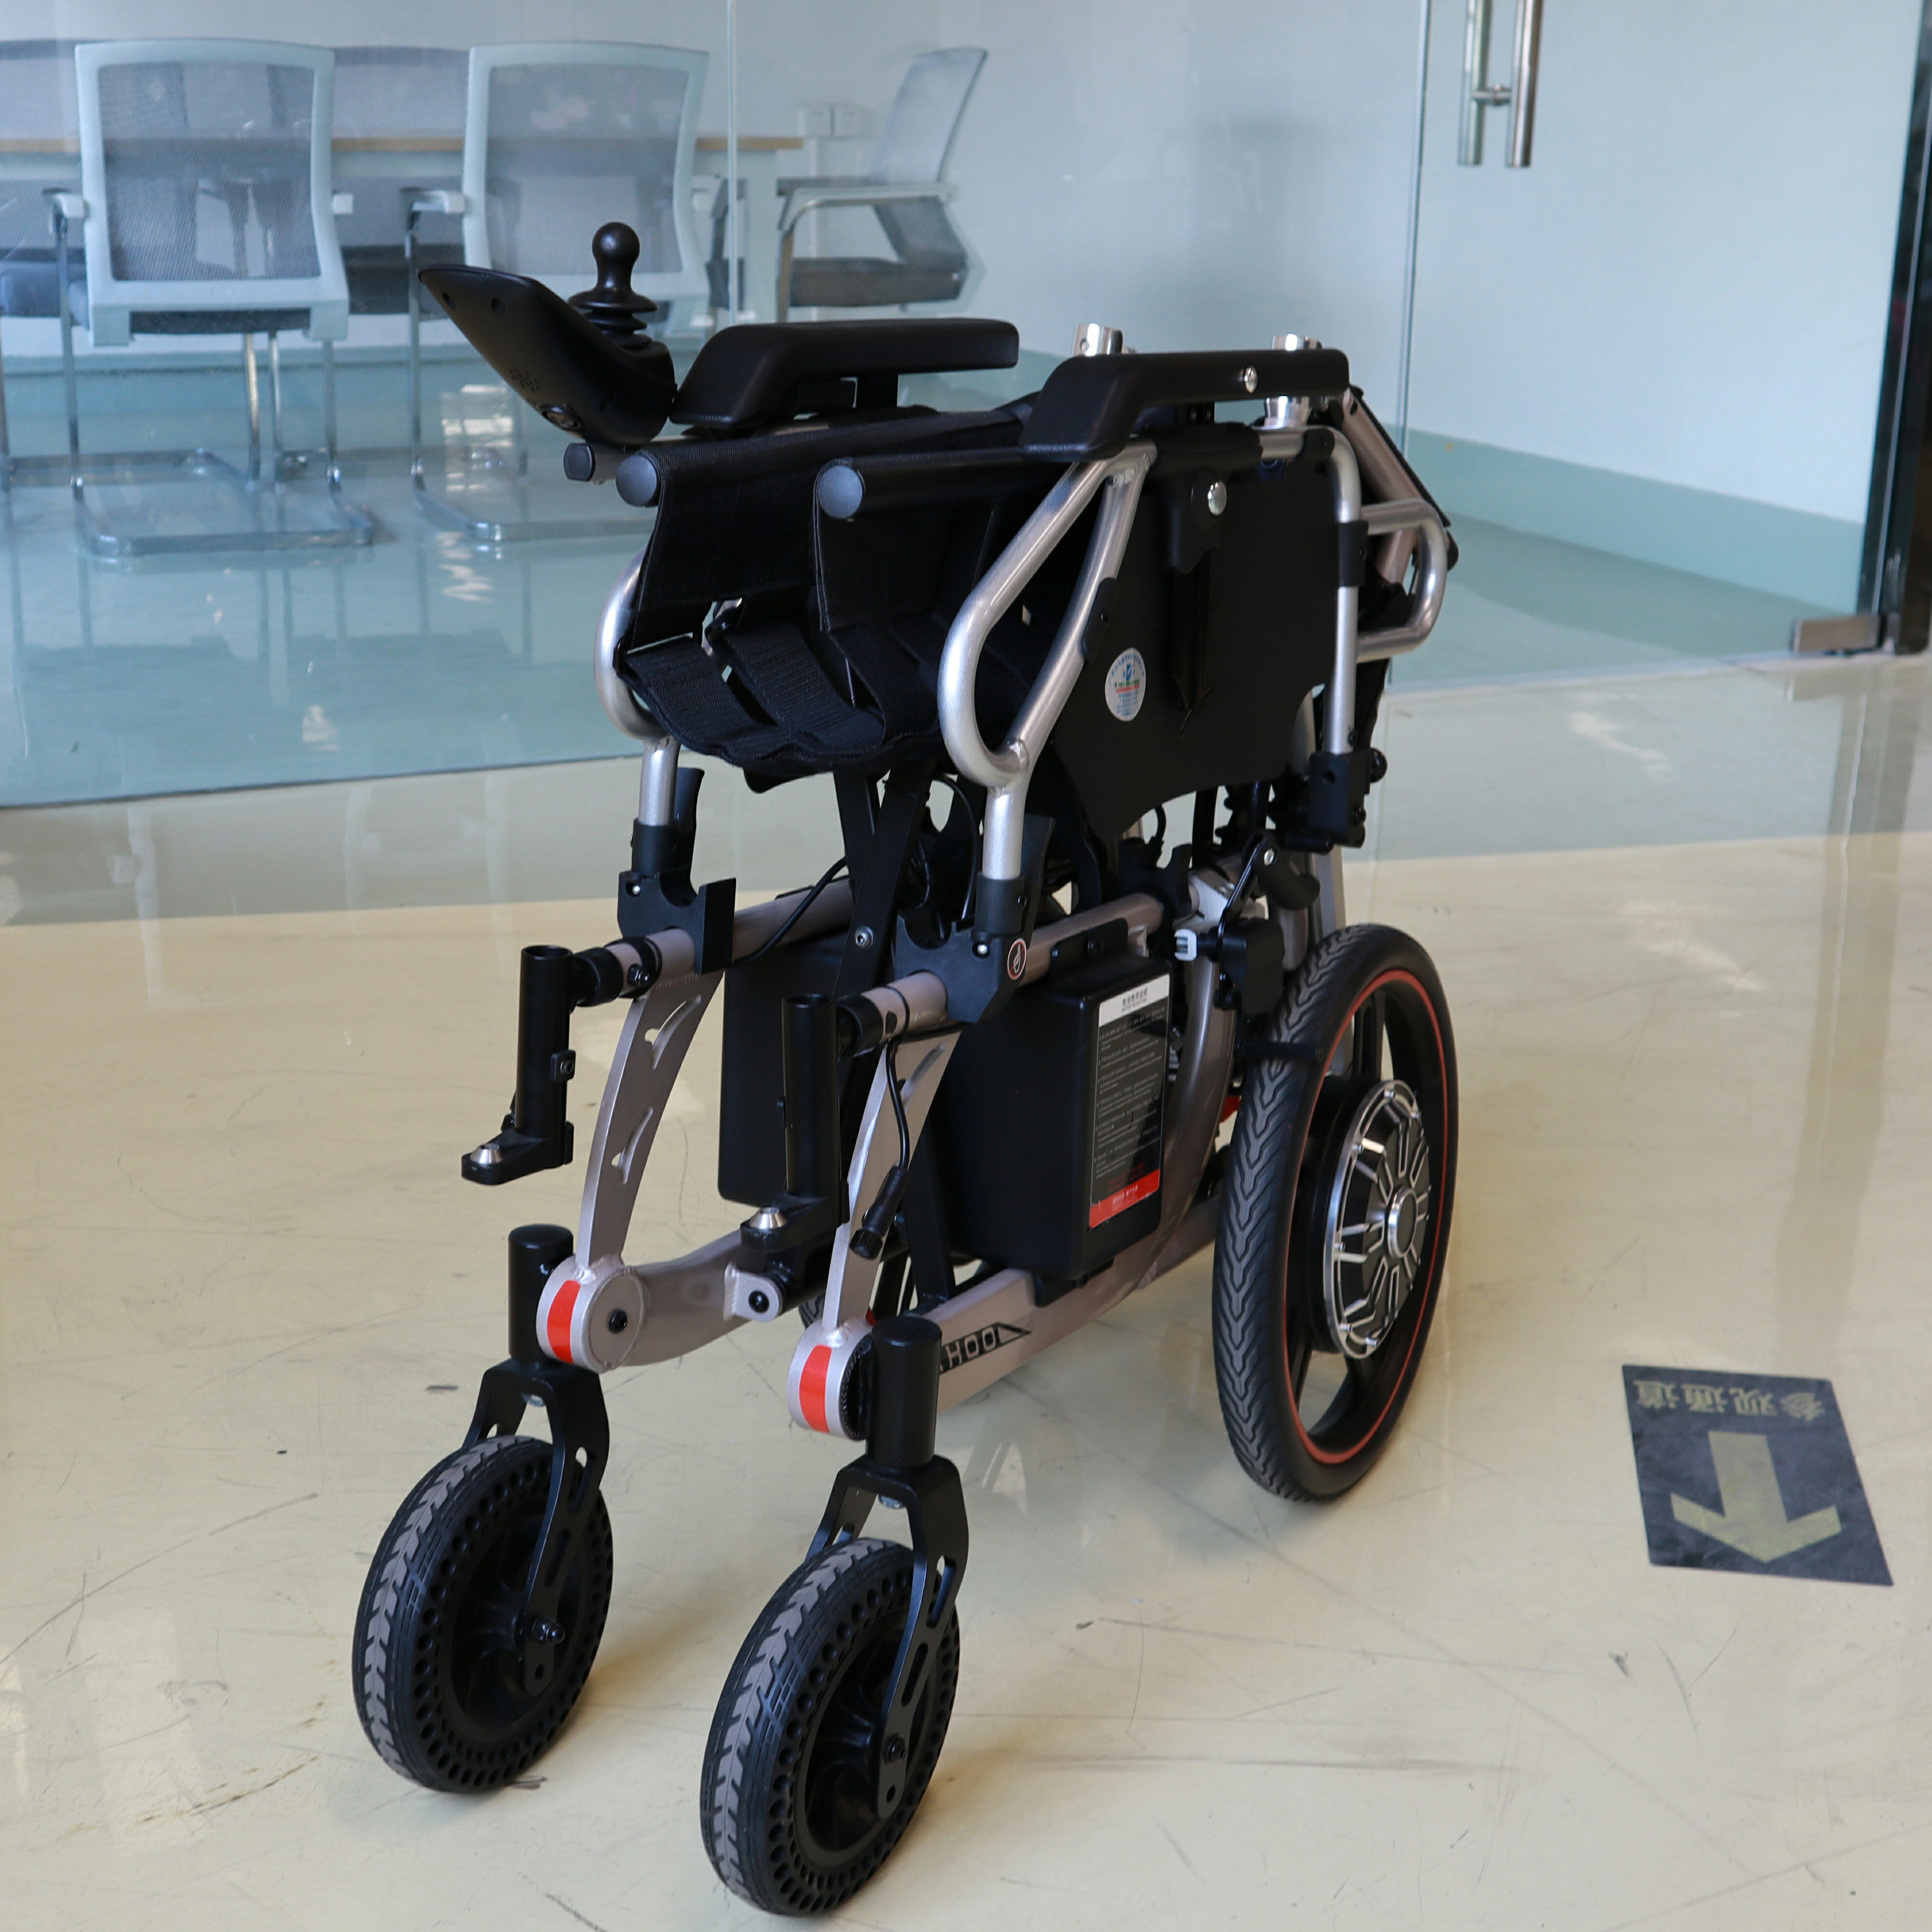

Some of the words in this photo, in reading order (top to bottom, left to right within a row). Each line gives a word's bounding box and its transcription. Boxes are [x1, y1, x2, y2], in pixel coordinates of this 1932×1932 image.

[940, 1326, 996, 1372] HOO
[1634, 1380, 1826, 1421] 参观通道
